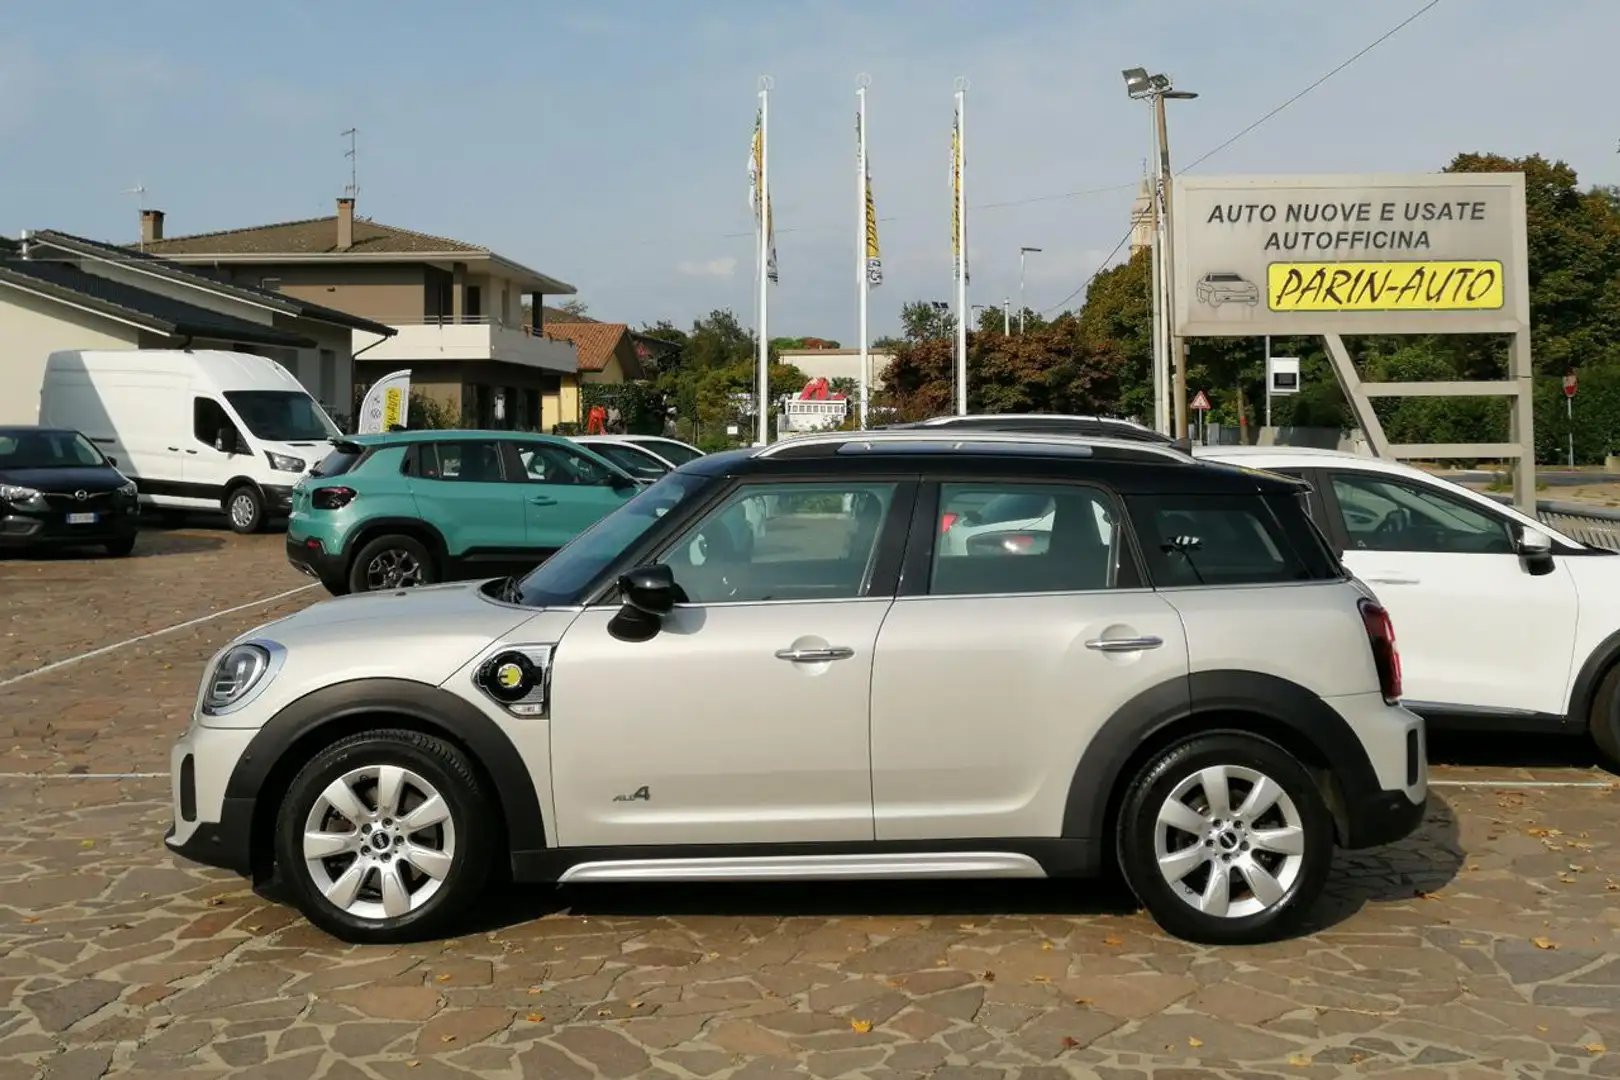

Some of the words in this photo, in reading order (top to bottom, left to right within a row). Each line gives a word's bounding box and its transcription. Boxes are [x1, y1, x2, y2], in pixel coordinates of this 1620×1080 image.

[1207, 204, 1277, 223] AUTO
[1285, 203, 1371, 222] NUOVE
[1380, 203, 1396, 221] E
[1404, 202, 1486, 221] USATE
[1264, 231, 1430, 250] AUTOFFICINA
[1276, 266, 1495, 306] PARIN-AUTO
